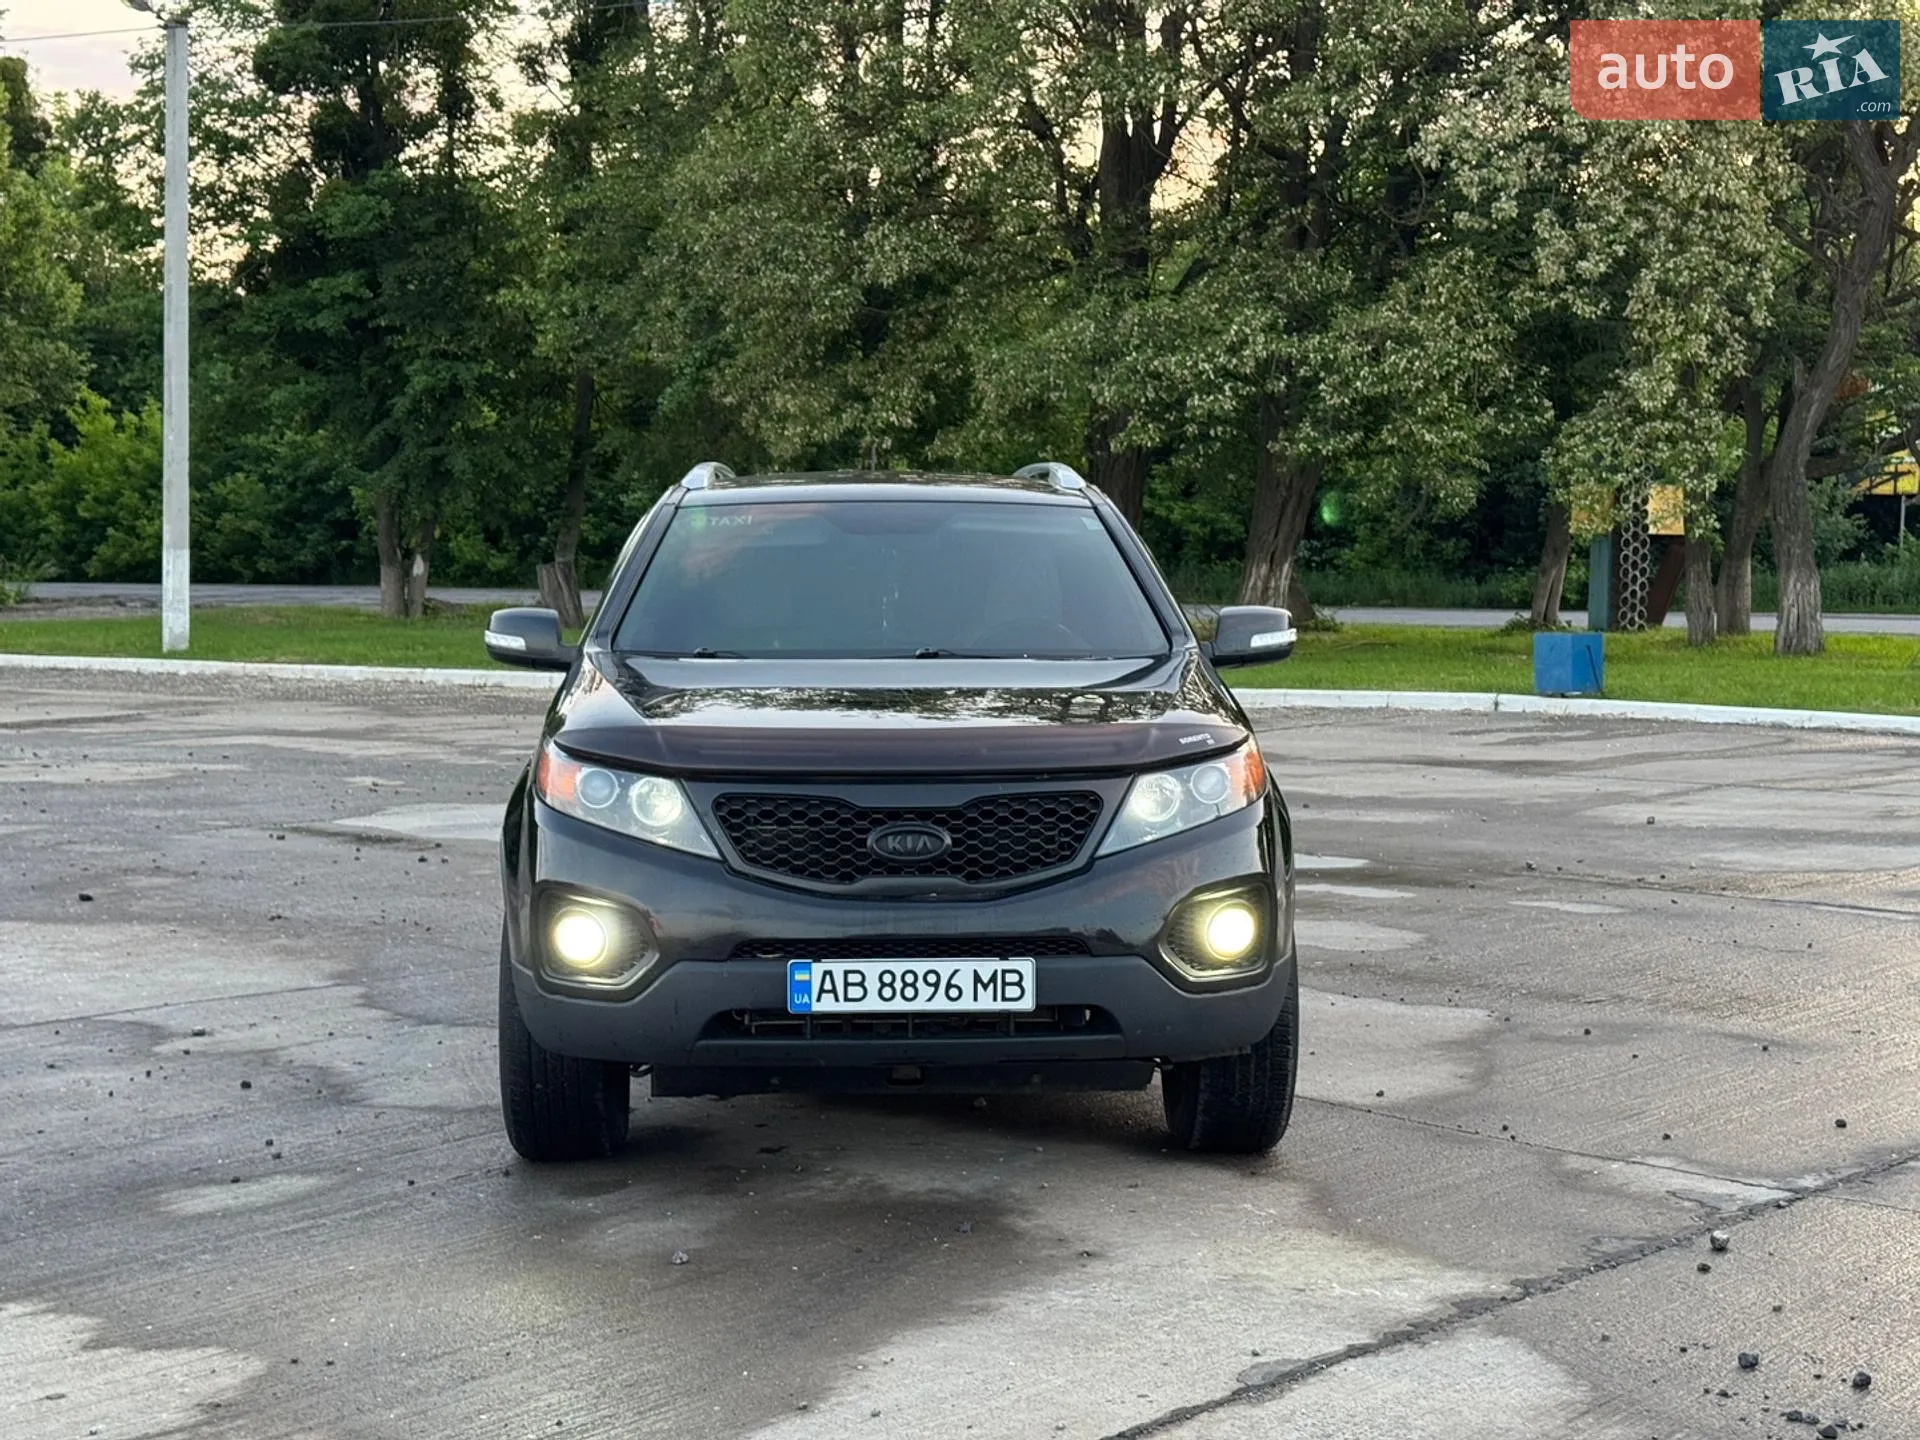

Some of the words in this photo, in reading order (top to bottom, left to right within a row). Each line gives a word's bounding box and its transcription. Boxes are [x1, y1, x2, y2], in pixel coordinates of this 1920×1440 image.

[887, 834, 934, 853] KIA
[815, 968, 868, 1003] AB
[877, 968, 964, 1003] 8896
[972, 968, 1026, 1003] MB
[794, 993, 810, 1004] UA
